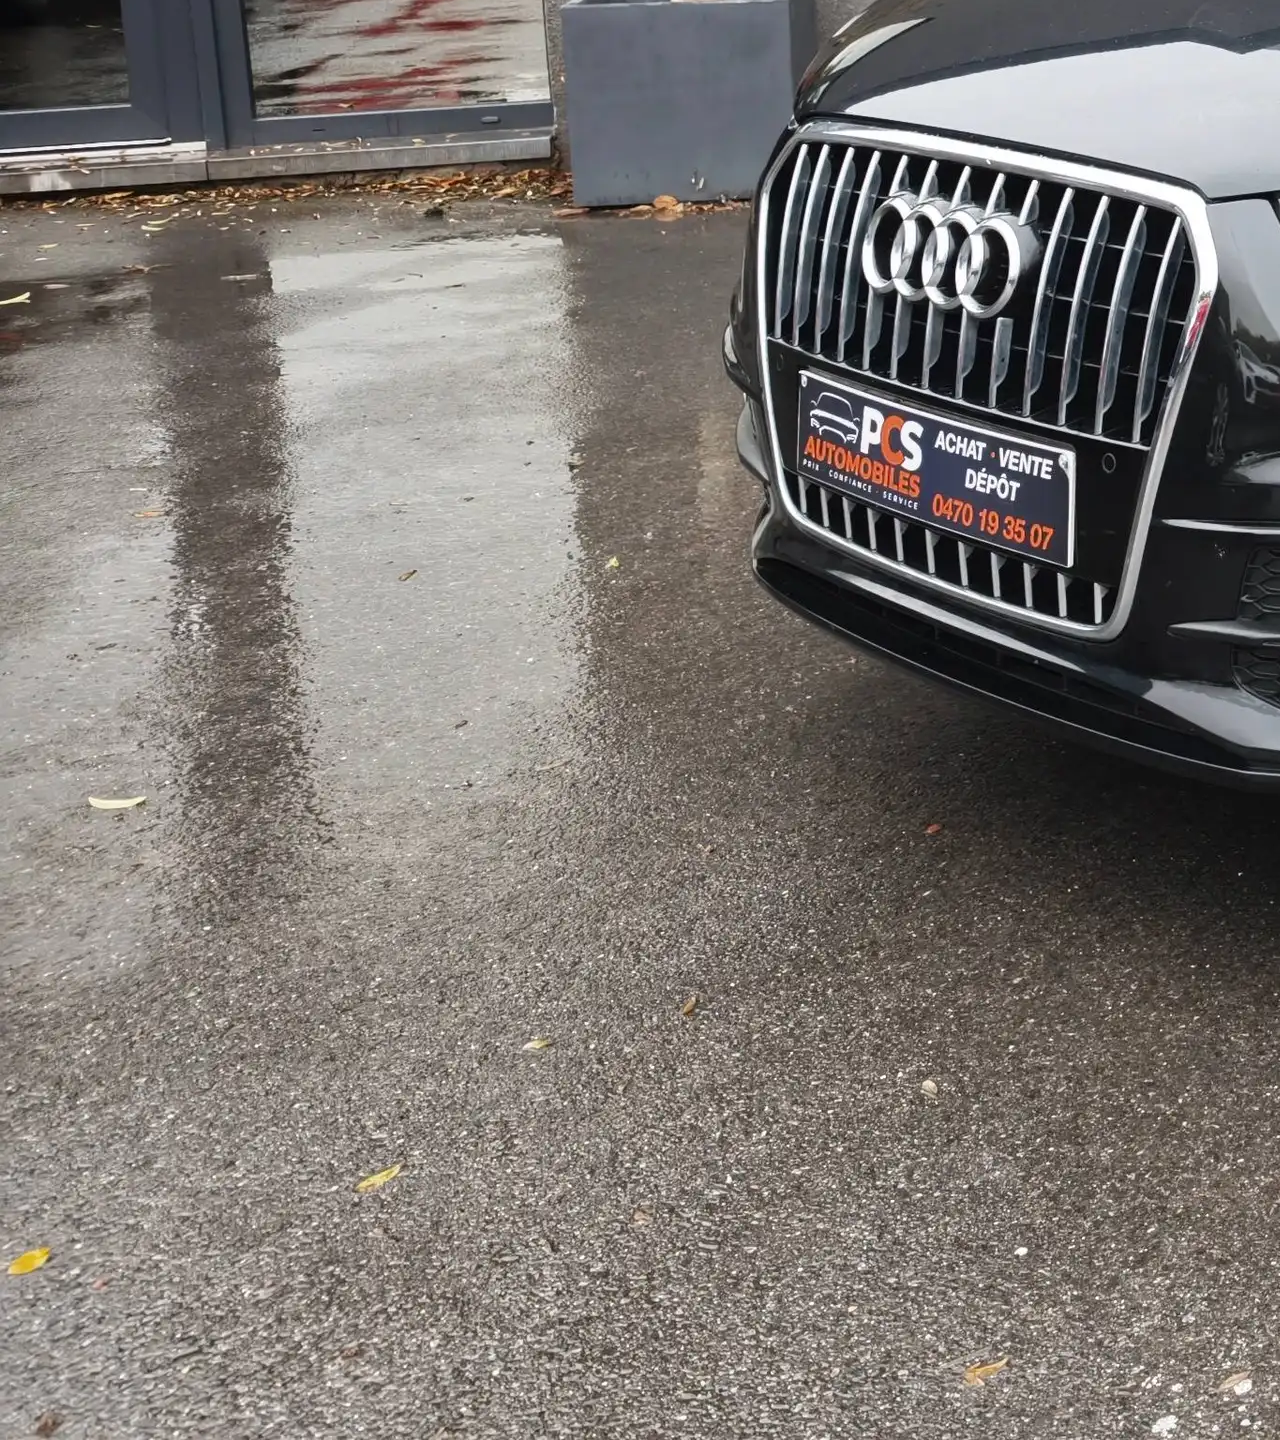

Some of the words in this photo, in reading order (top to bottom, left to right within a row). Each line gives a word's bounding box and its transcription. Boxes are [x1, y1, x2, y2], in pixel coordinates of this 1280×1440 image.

[859, 404, 925, 472] PCS
[934, 429, 987, 461] ACHAT
[998, 447, 1054, 480] VENTE
[802, 458, 820, 471] PRIX
[828, 469, 873, 494] CONFIANCE
[882, 491, 919, 511] SERVICE
[804, 436, 921, 498] AUTOMOBILES
[965, 468, 1021, 502] DÉPÔT
[931, 494, 974, 527] 0470
[978, 510, 1000, 536] 19
[1003, 516, 1026, 544] 35
[1029, 524, 1055, 551] 07
